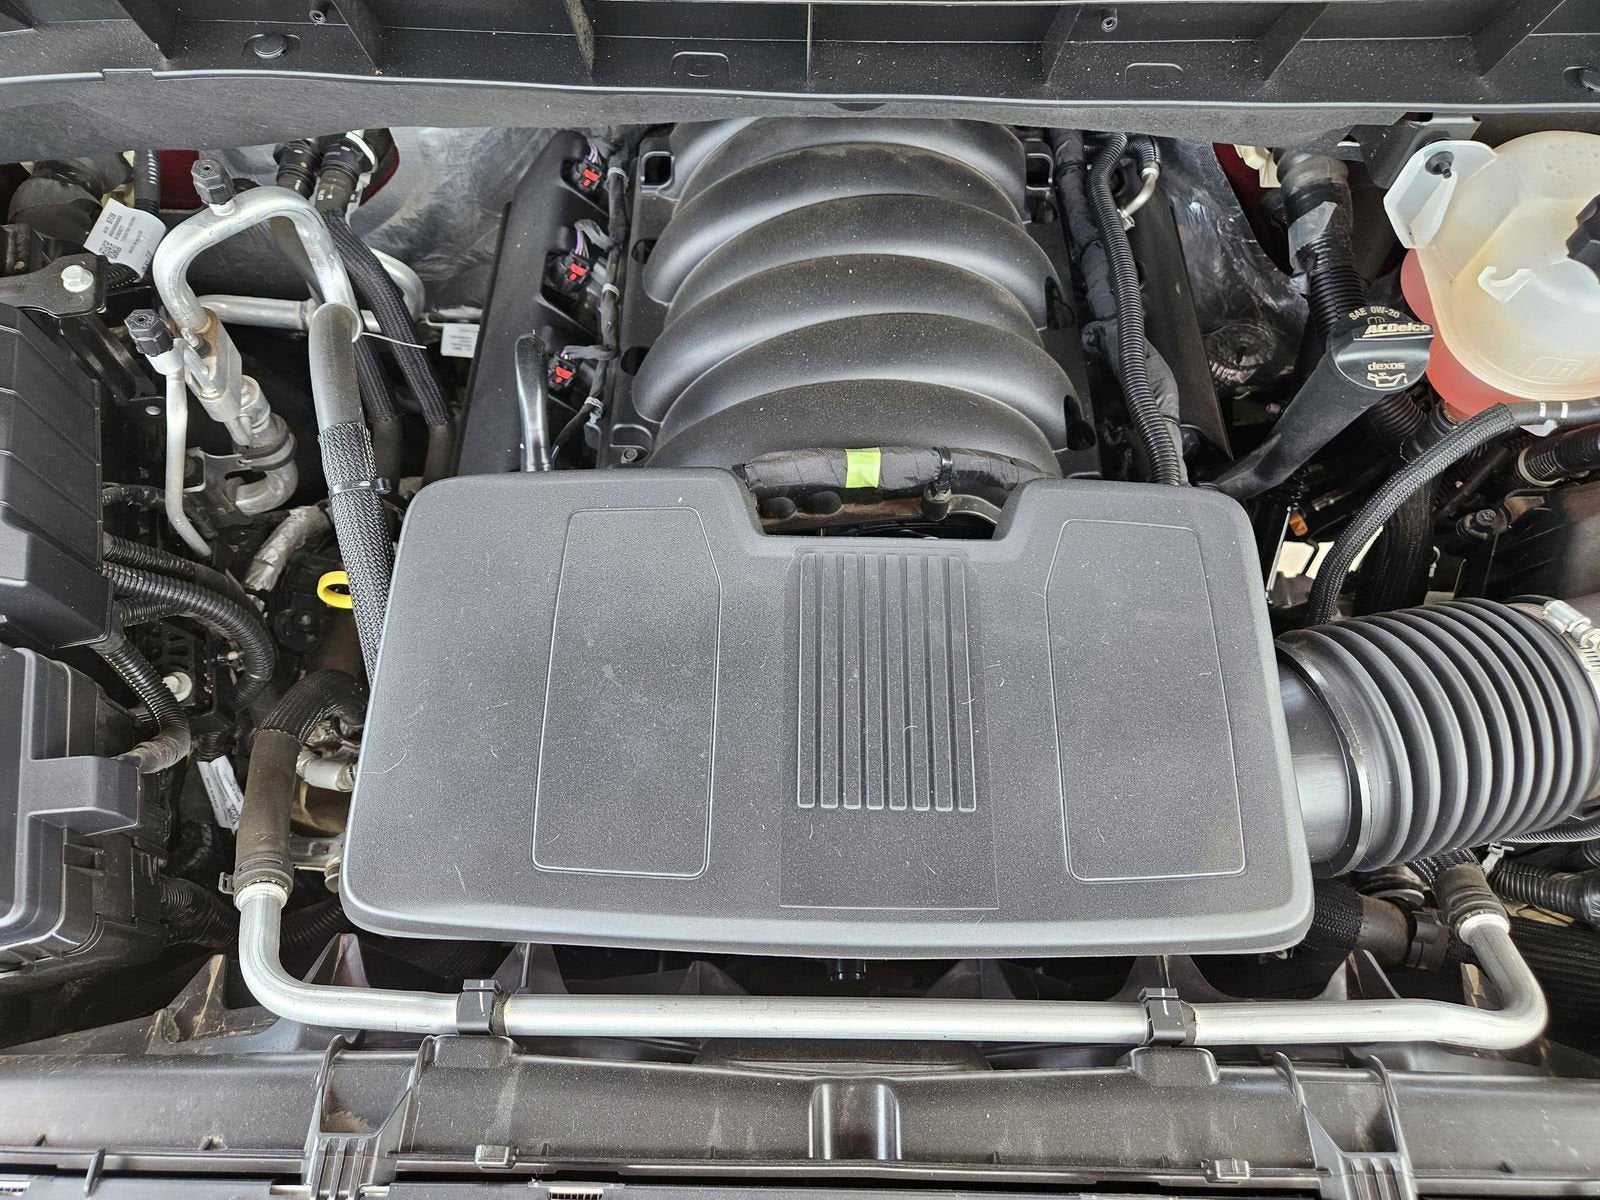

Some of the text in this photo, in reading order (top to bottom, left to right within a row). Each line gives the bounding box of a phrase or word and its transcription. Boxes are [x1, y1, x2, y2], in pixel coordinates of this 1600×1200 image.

[1348, 306, 1400, 321] SAE 0W-20
[1364, 322, 1432, 335] ACDelco
[1367, 361, 1406, 371] dexos
